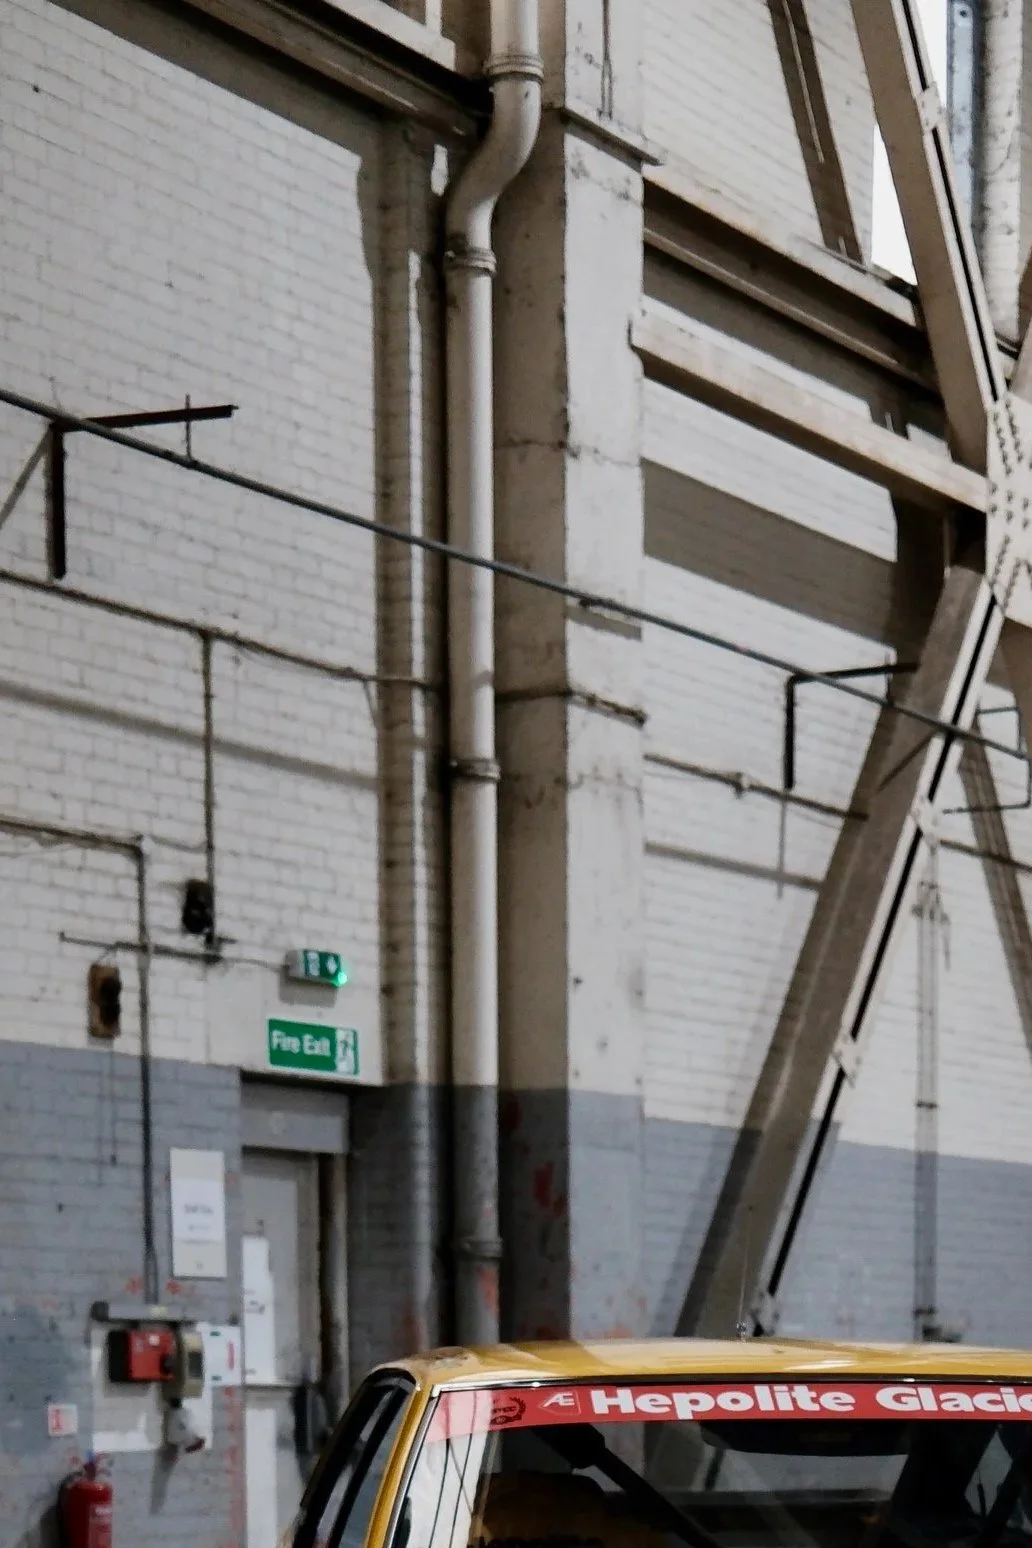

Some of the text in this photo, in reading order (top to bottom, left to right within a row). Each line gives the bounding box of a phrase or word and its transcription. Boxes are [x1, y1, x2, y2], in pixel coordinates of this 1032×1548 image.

[271, 1029, 331, 1057] Fire Exit
[590, 1385, 856, 1420] Hepolite
